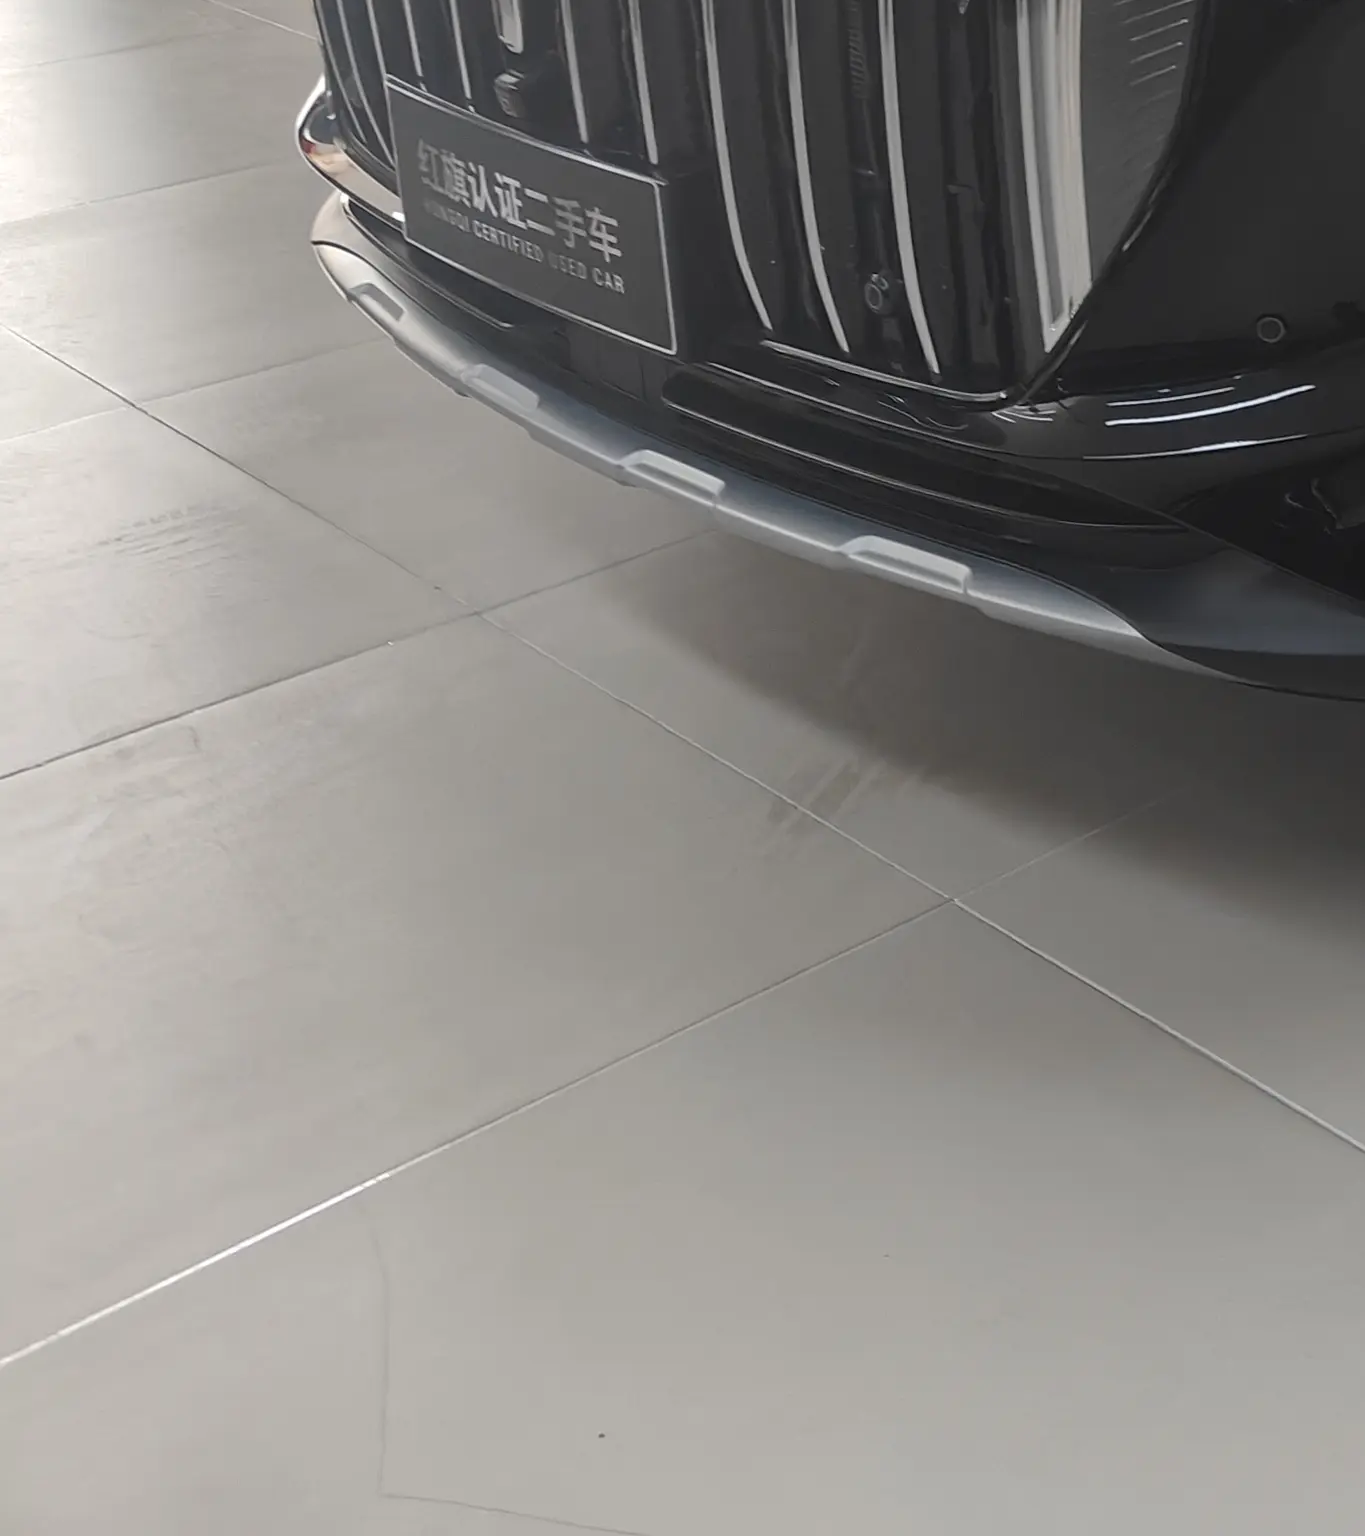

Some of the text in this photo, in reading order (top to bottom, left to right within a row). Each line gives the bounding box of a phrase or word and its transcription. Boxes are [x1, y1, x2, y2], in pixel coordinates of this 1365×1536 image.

[417, 139, 623, 263] 红旗认证二手车
[472, 219, 545, 263] CERTIFIED
[592, 267, 625, 294] CAR
